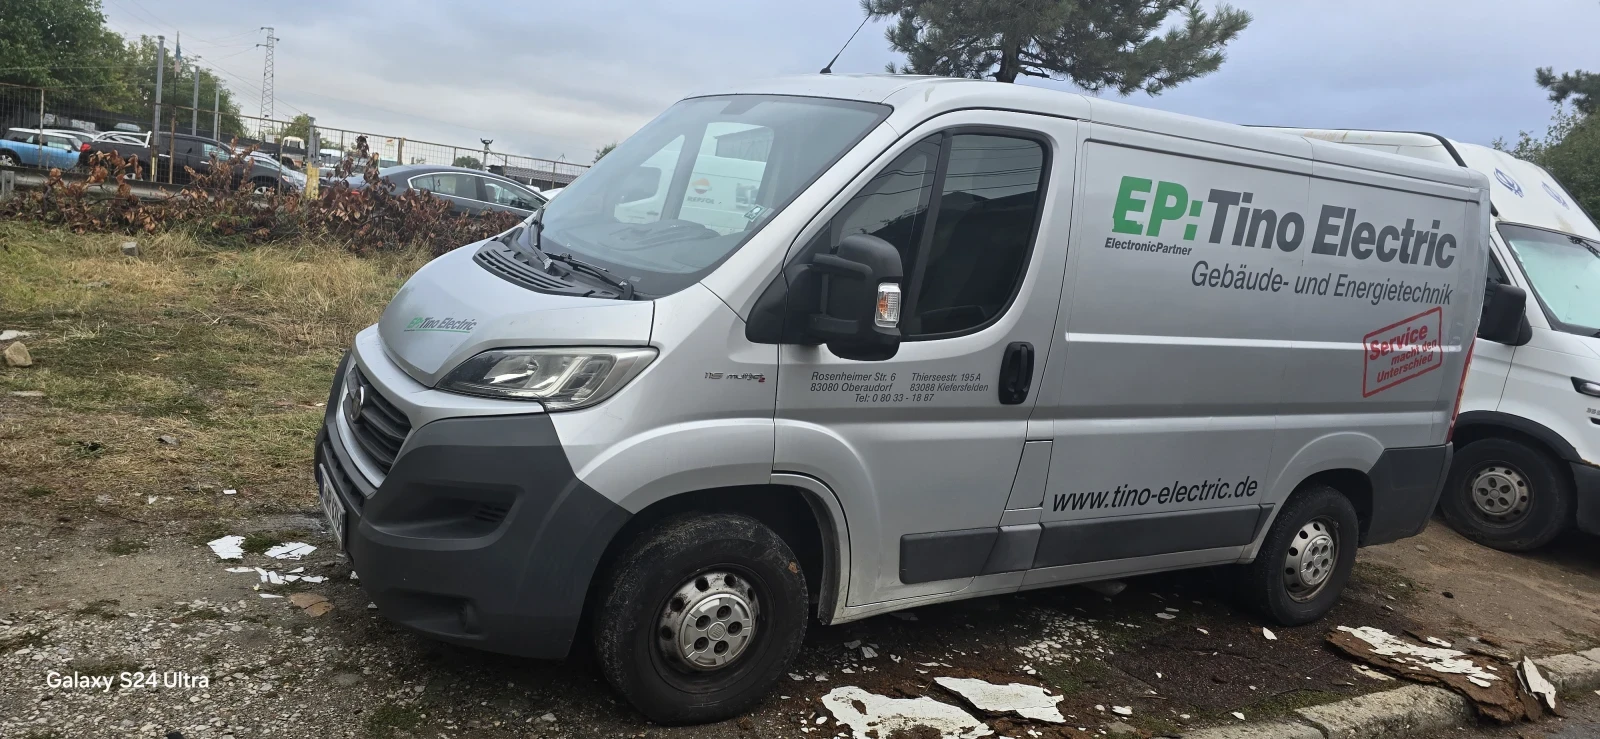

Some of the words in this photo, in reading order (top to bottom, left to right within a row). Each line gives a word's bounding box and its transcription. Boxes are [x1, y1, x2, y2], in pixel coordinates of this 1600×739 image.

[1311, 204, 1457, 269] Electric
[1104, 237, 1192, 256] ElectronicPartner
[1191, 260, 1289, 292] Gebäude-
[1294, 272, 1331, 296] und
[1333, 273, 1454, 306] Energietechnik
[437, 317, 477, 331] Electric
[1369, 325, 1428, 360] Service
[1391, 345, 1420, 365] macht
[1422, 339, 1437, 352] den
[811, 371, 872, 381] Rosenheimer
[873, 372, 887, 381] Str.
[890, 372, 897, 381] 6
[912, 372, 957, 381] Thierseestr.
[1376, 351, 1434, 383] Unterschied
[810, 382, 839, 392] 83080
[841, 382, 893, 392] Oberaudorf
[909, 383, 936, 392] 83088
[936, 382, 989, 392] Kiefersfelden
[855, 393, 870, 402] Tel:
[872, 393, 878, 402] 0
[880, 393, 891, 402] 80
[892, 393, 904, 402] 33
[912, 393, 922, 402] 18
[923, 393, 934, 402] 87
[1052, 475, 1258, 512] www.tino-electric.de
